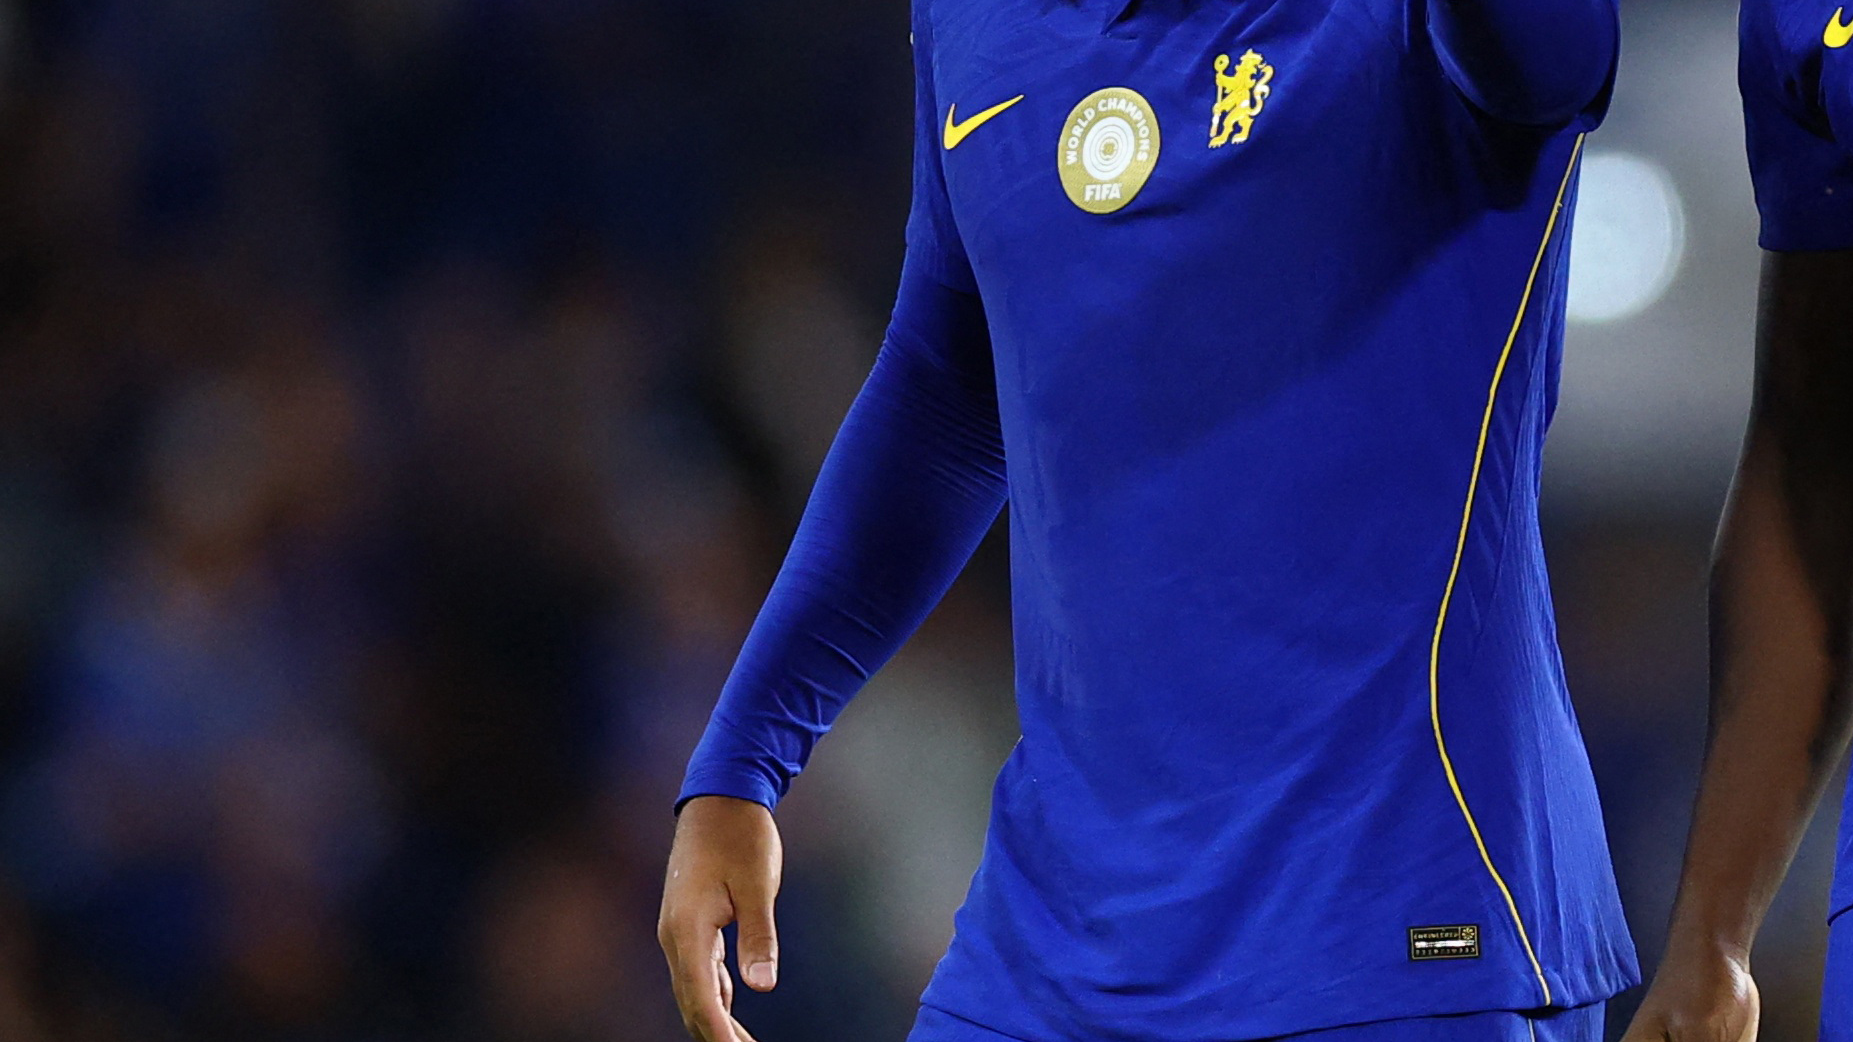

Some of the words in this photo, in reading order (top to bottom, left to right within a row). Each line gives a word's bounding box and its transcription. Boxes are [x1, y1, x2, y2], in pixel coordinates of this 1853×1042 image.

[1066, 107, 1096, 165] WORLD
[1098, 97, 1150, 161] CHAMPIONS
[1084, 183, 1121, 202] FIFA
